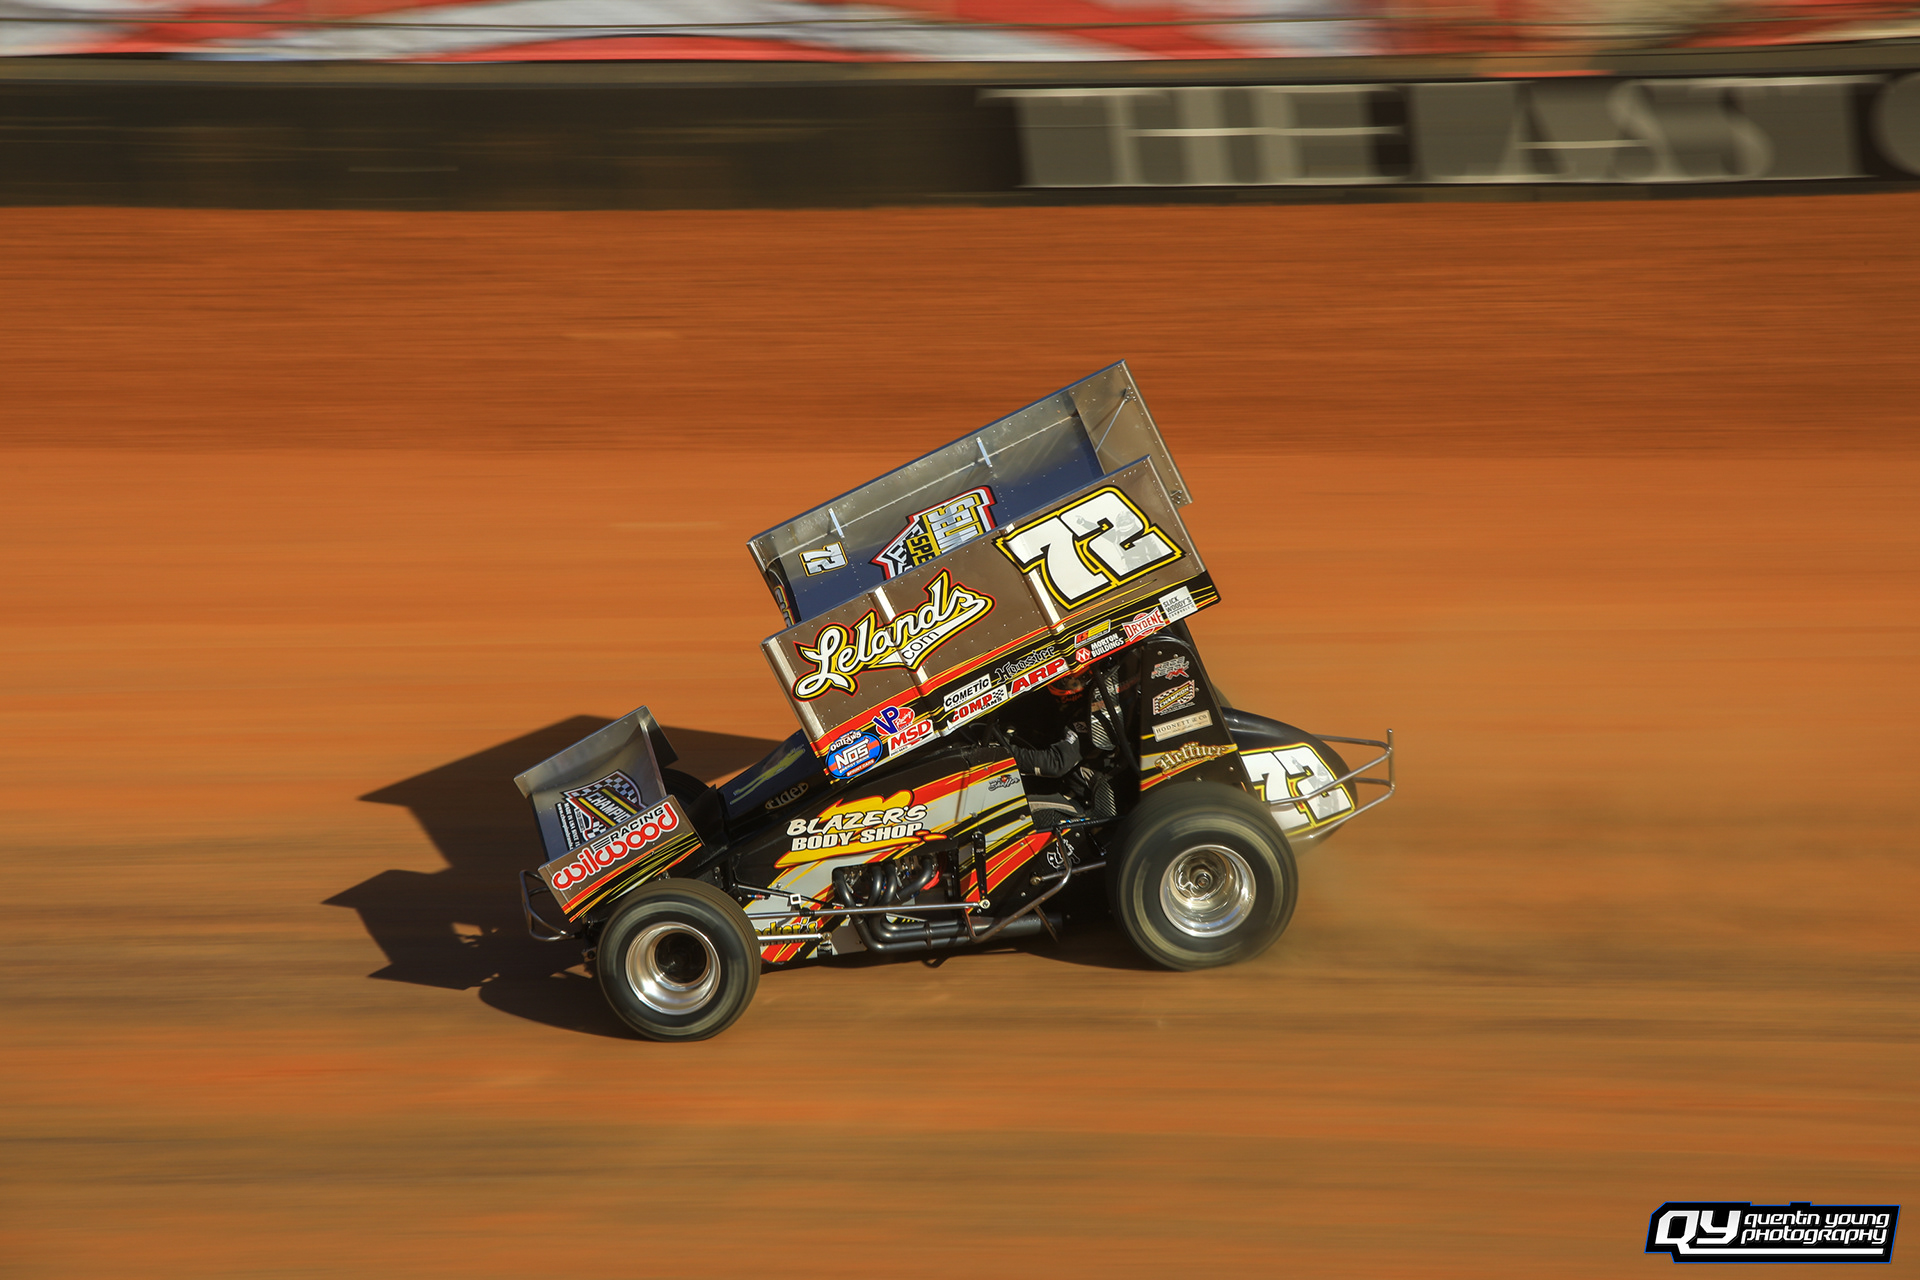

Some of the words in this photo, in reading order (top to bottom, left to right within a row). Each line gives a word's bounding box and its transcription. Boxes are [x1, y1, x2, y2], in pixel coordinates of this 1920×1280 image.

[1003, 489, 1178, 604] 72
[1162, 595, 1179, 608] SLICK
[796, 572, 990, 698] Lelands
[1123, 609, 1164, 640] DRYDENE
[1090, 632, 1119, 651] MORTON
[1090, 636, 1125, 658] BUILDINGS
[994, 646, 1055, 684] Hoosier
[1011, 659, 1065, 694] ARP
[981, 697, 1003, 710] CAMS
[1159, 686, 1190, 708] CHAMPION
[873, 706, 899, 735] VP
[890, 720, 932, 751] MSD
[835, 738, 869, 770] NOS
[1239, 745, 1353, 832] 72
[609, 807, 664, 842] RACING
[786, 804, 928, 837] BLAZER'S
[552, 803, 679, 890] wilwood
[791, 831, 854, 852] BODY
[860, 822, 924, 843] SHOP
